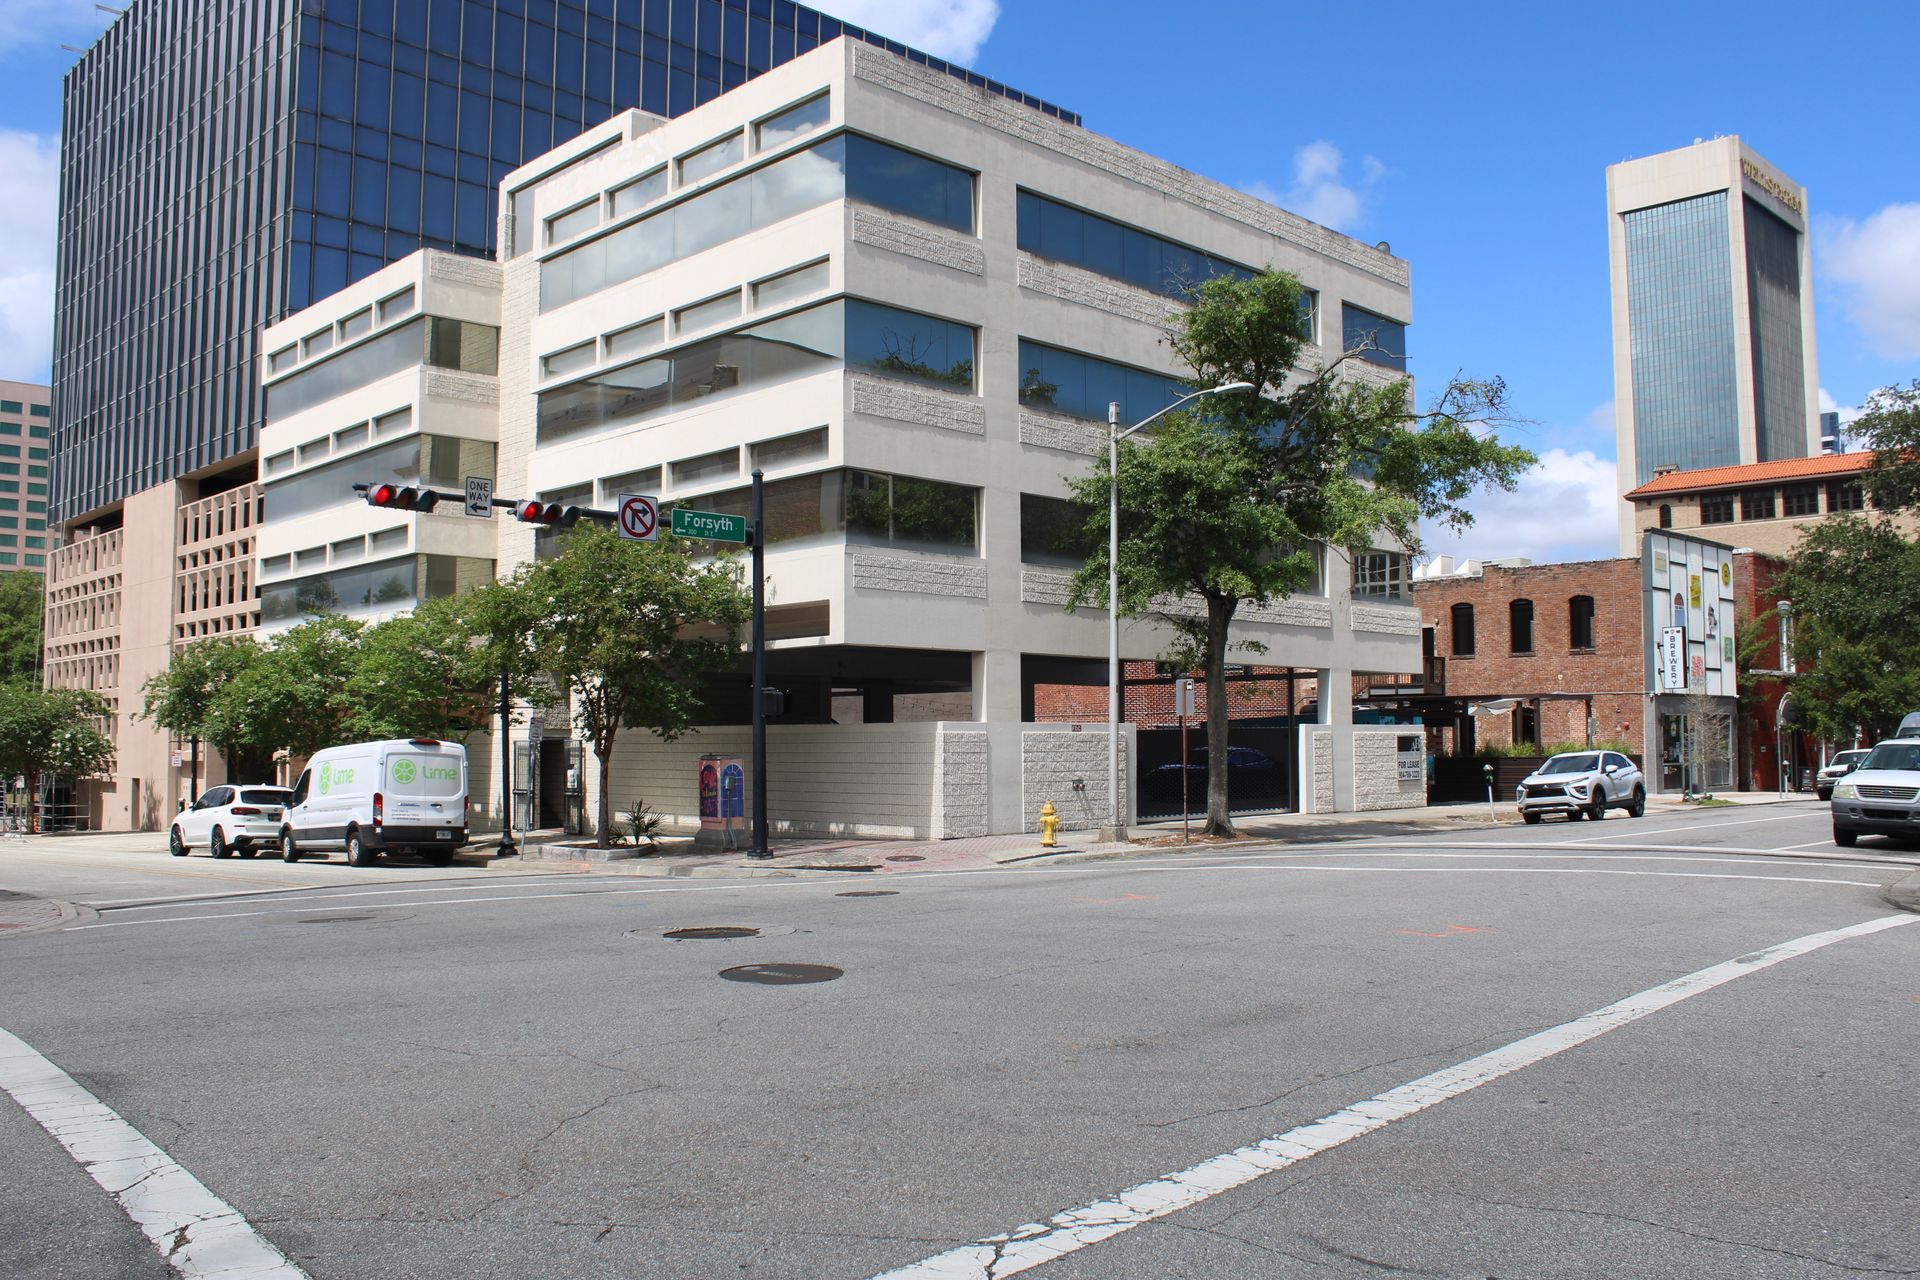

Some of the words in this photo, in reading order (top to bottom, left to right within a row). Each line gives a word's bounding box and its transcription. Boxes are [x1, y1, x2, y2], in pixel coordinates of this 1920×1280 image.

[470, 481, 489, 491] ONE
[469, 492, 489, 502] WAY
[685, 513, 733, 532] Forsyth
[1669, 635, 1678, 687] BREWERY
[334, 767, 355, 785] Lime
[422, 765, 458, 781] Lime
